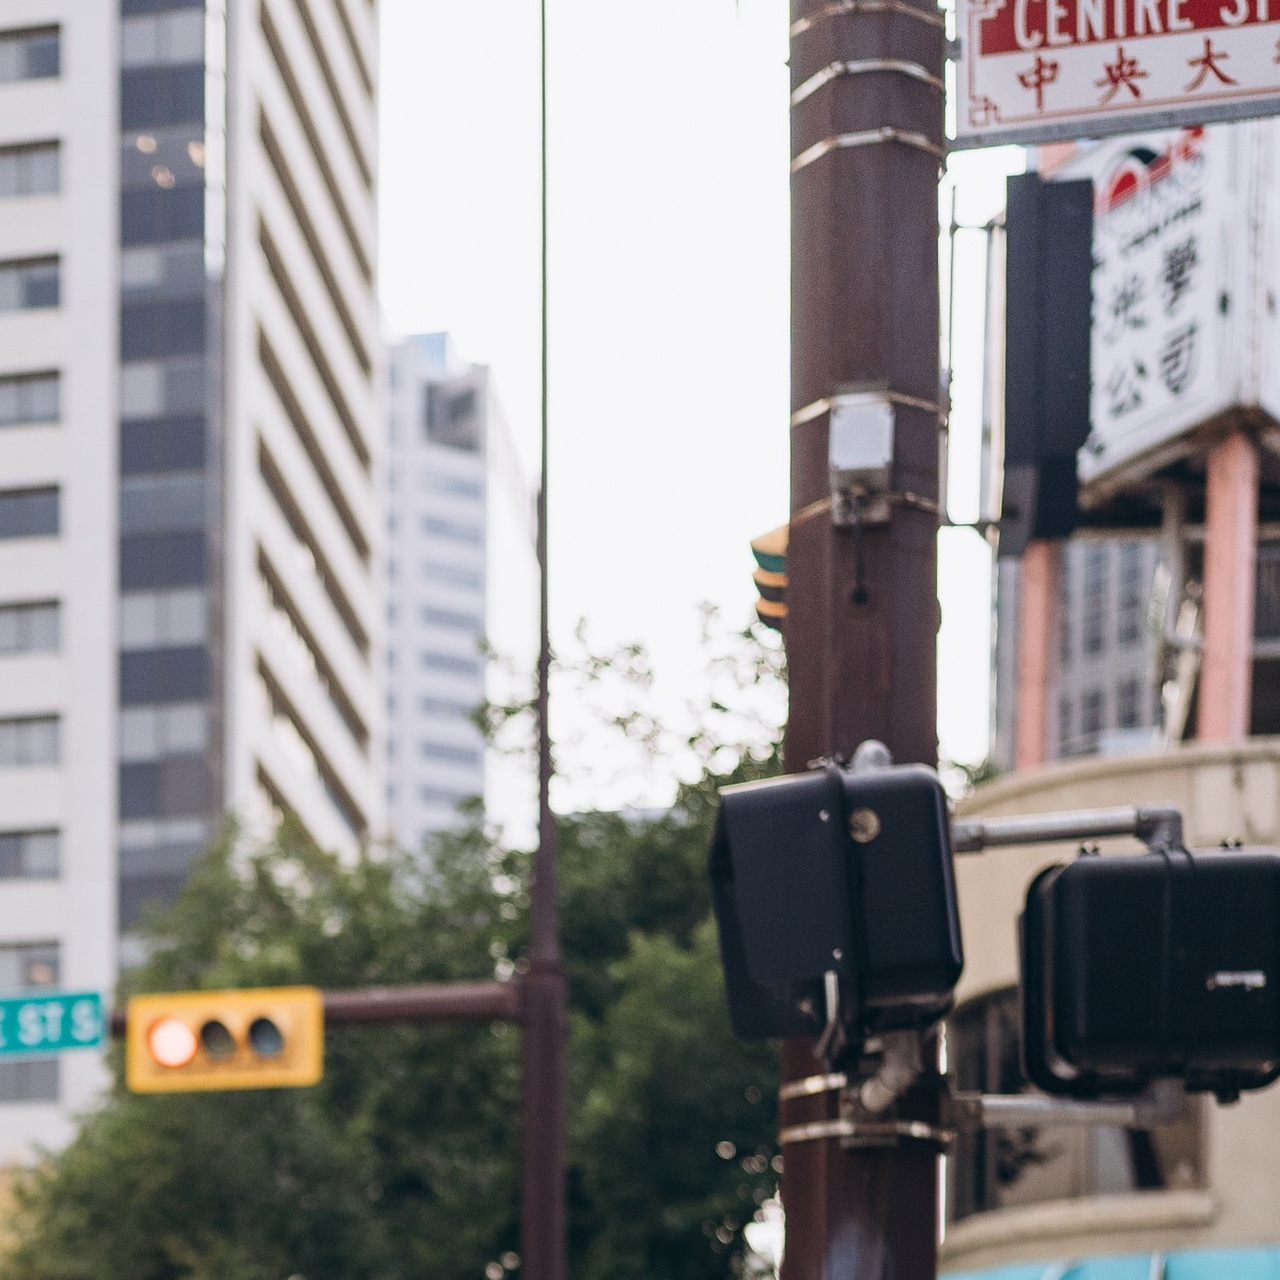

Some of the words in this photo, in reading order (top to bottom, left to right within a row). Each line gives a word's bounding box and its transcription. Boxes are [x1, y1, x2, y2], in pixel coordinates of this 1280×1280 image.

[1018, 36, 1280, 111] 中央大
[18, 1001, 63, 1046] ST
[70, 1000, 98, 1042] S
